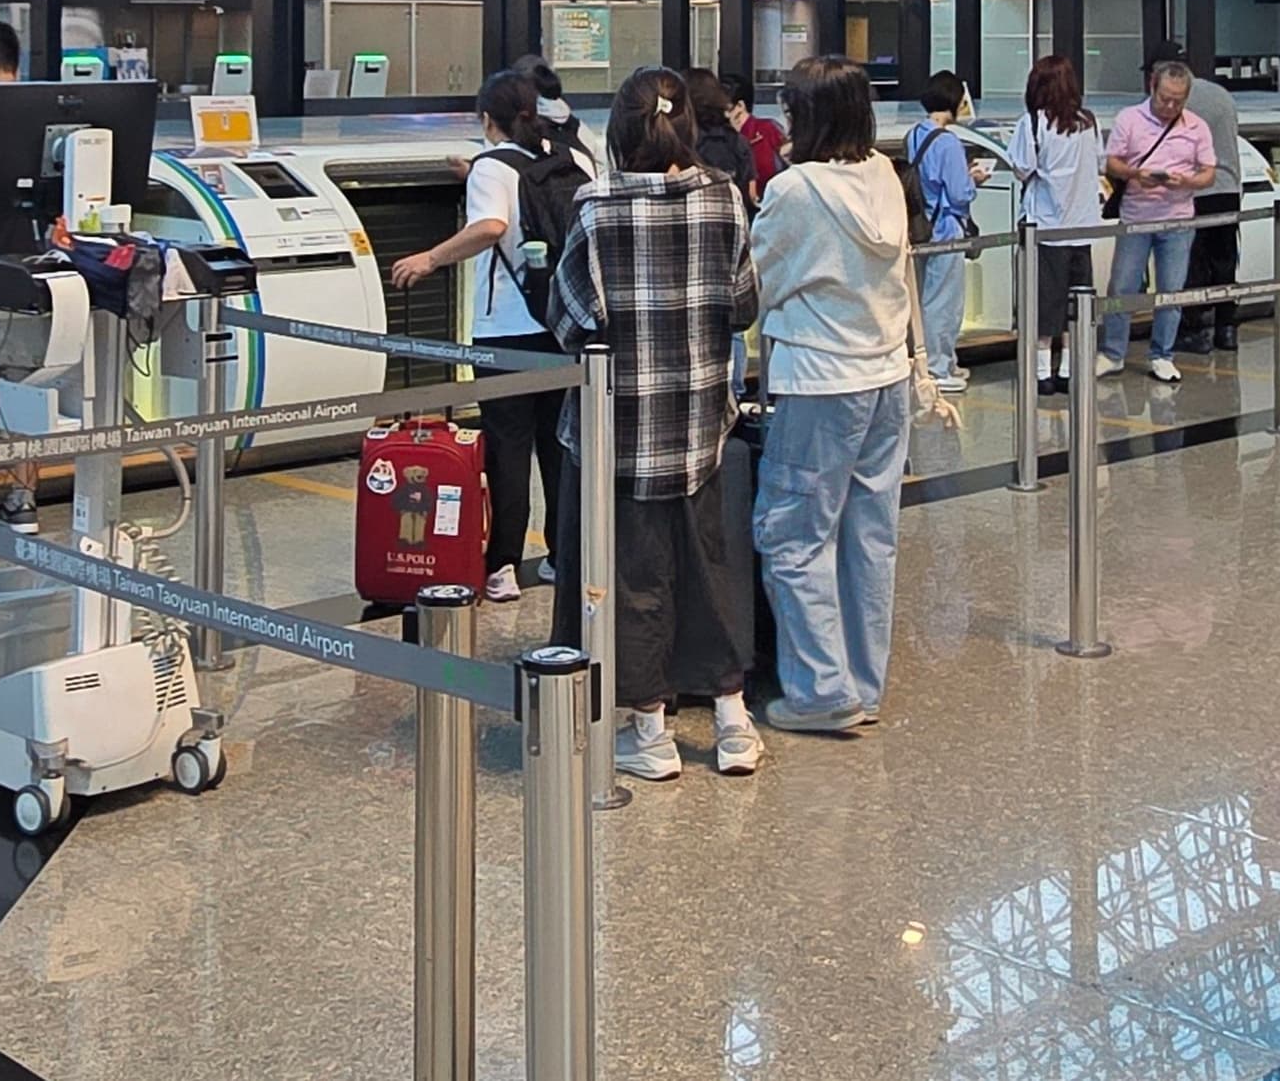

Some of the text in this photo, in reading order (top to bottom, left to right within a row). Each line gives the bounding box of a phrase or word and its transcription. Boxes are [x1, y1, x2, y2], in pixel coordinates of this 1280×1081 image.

[464, 347, 495, 364] Airport
[124, 401, 357, 443] Taiwan Taoyuan International Airport
[112, 569, 355, 660] Taiwan Taoyuan International Airport
